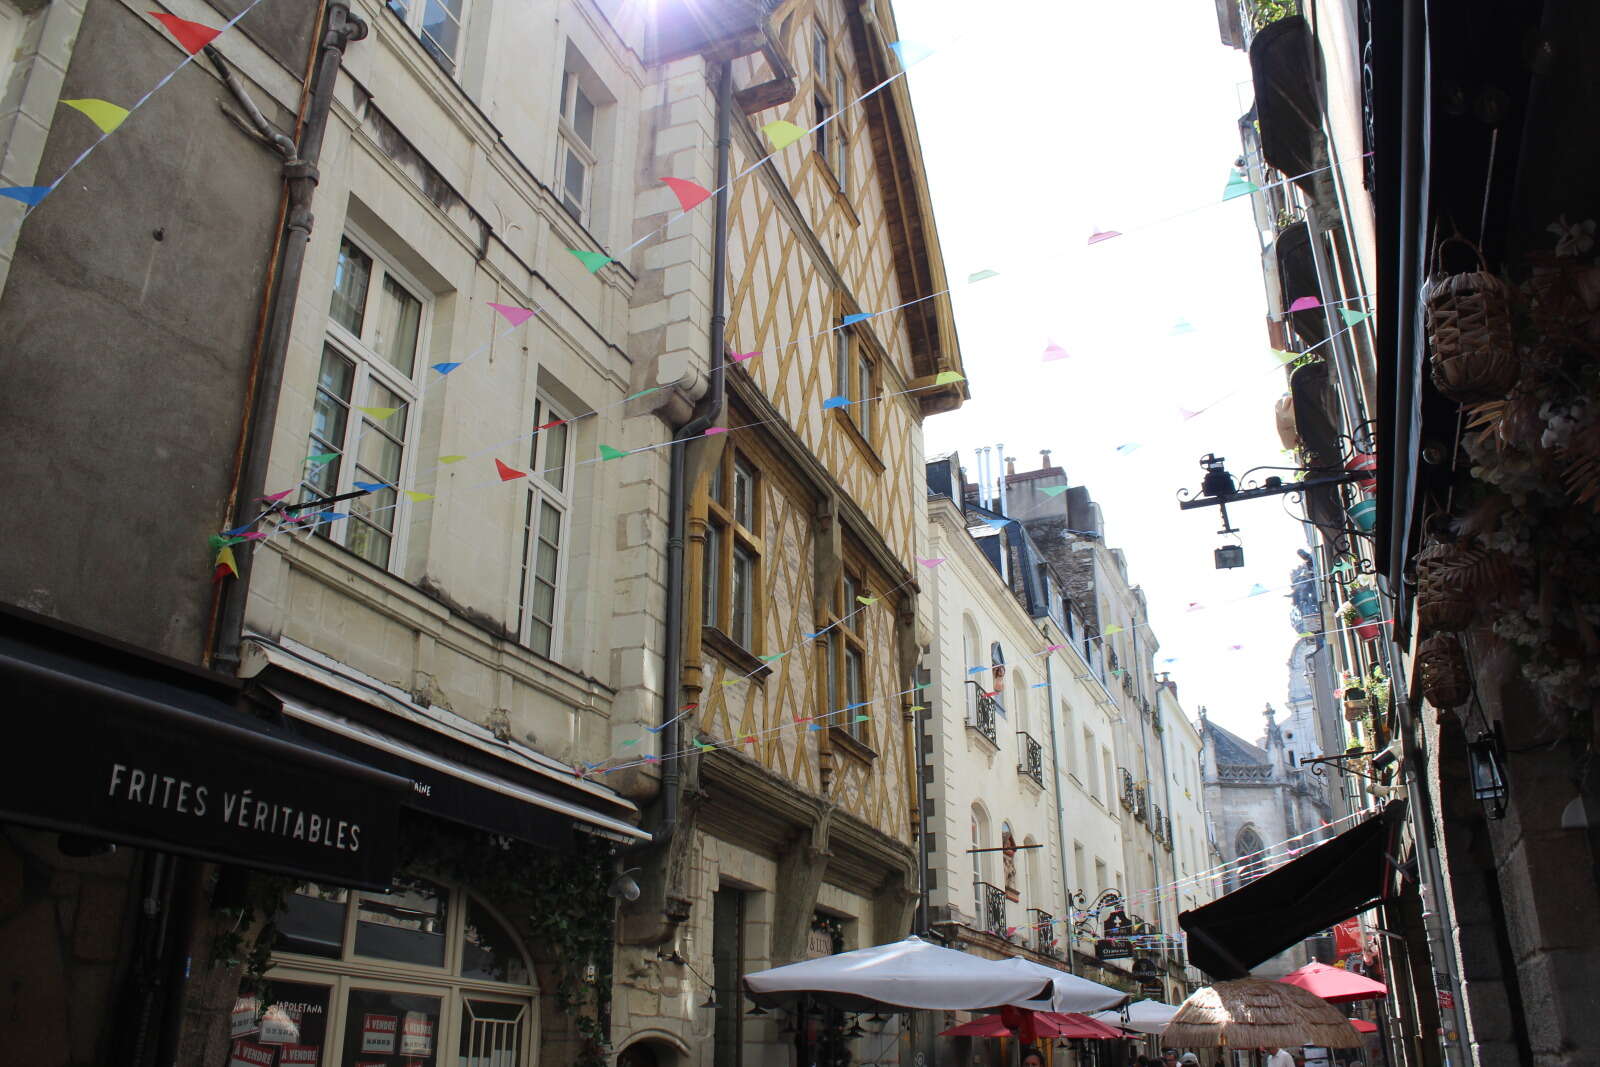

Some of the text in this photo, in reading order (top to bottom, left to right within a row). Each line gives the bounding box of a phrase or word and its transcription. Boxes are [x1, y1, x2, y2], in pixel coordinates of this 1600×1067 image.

[108, 763, 361, 853] FRITES VÉRITABLES
[242, 1046, 273, 1065] VENDRE
[289, 1048, 317, 1061] VENDRE
